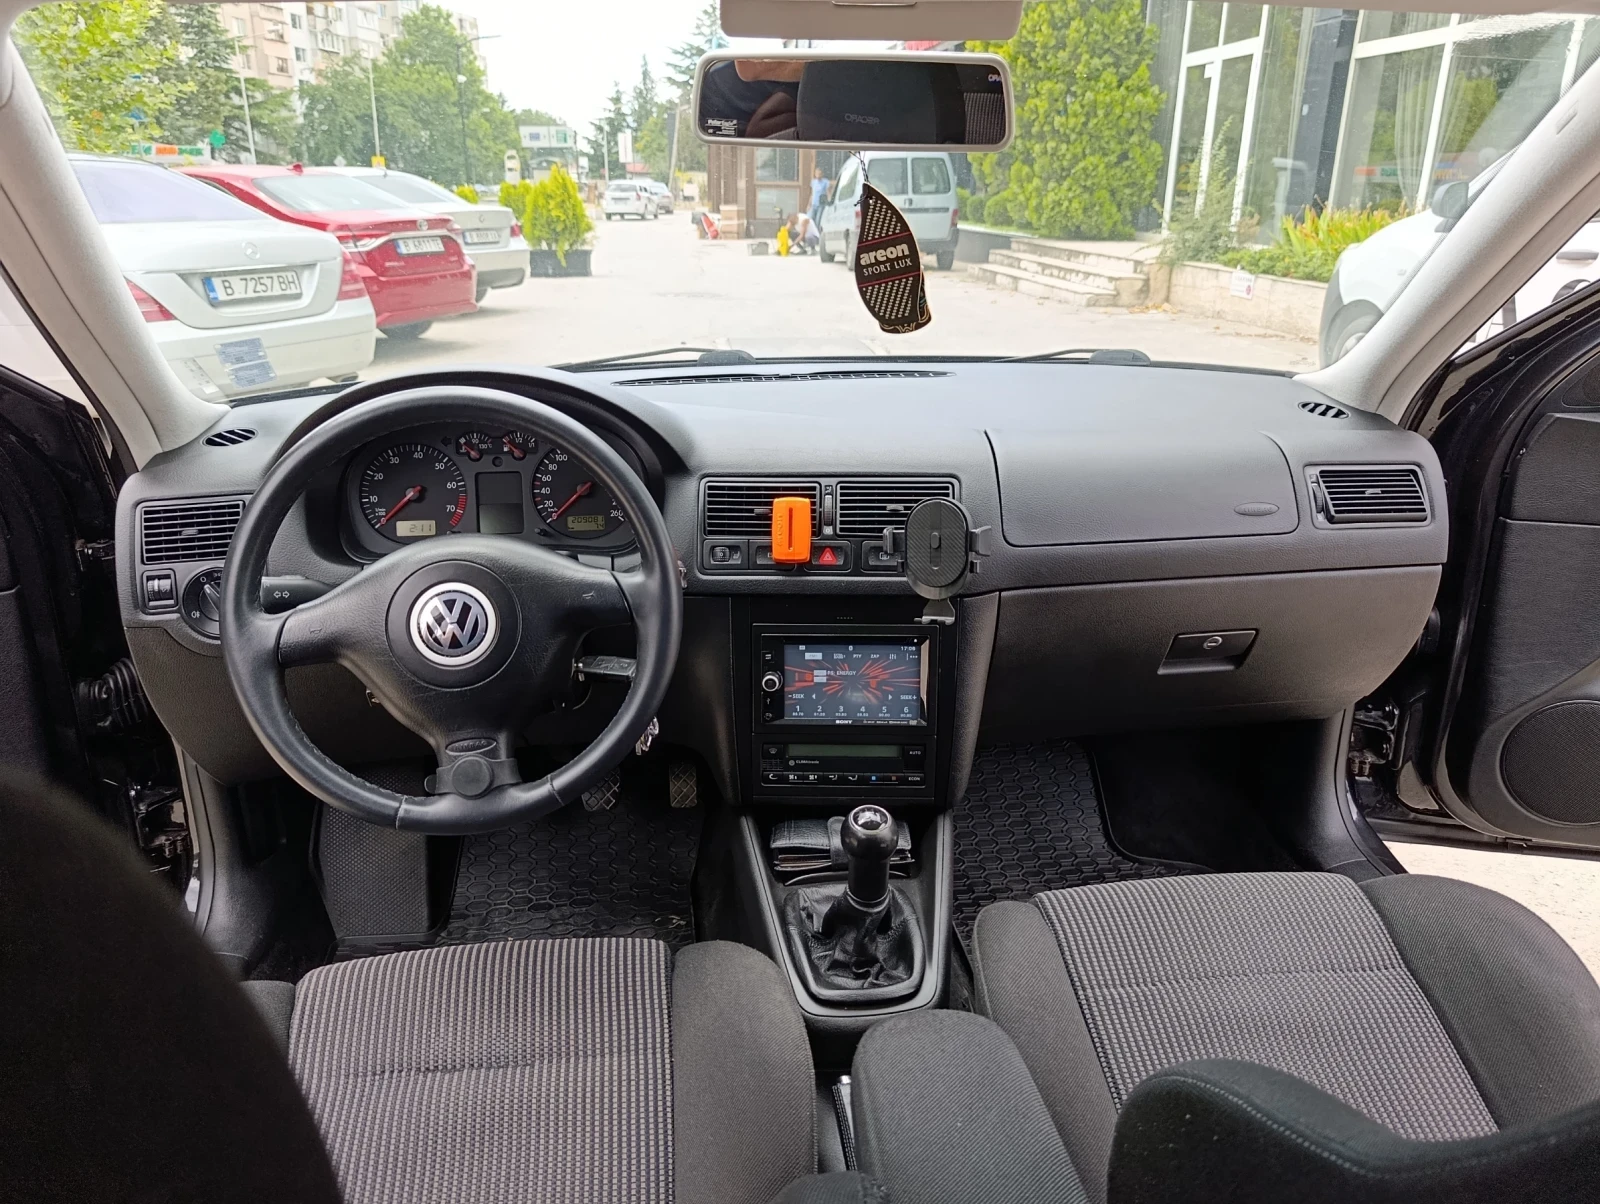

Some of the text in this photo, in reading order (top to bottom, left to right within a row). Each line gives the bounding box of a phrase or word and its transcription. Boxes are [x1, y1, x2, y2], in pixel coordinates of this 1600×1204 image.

[860, 243, 909, 265] areon
[863, 258, 912, 276] SPORT LUX
[222, 274, 298, 296] B 7257 BH
[413, 451, 423, 459] 40
[435, 462, 445, 470] 50
[541, 474, 552, 482] 60
[446, 481, 457, 489] 60
[369, 495, 378, 503] 10
[544, 500, 554, 508] 20
[610, 509, 624, 517] 260
